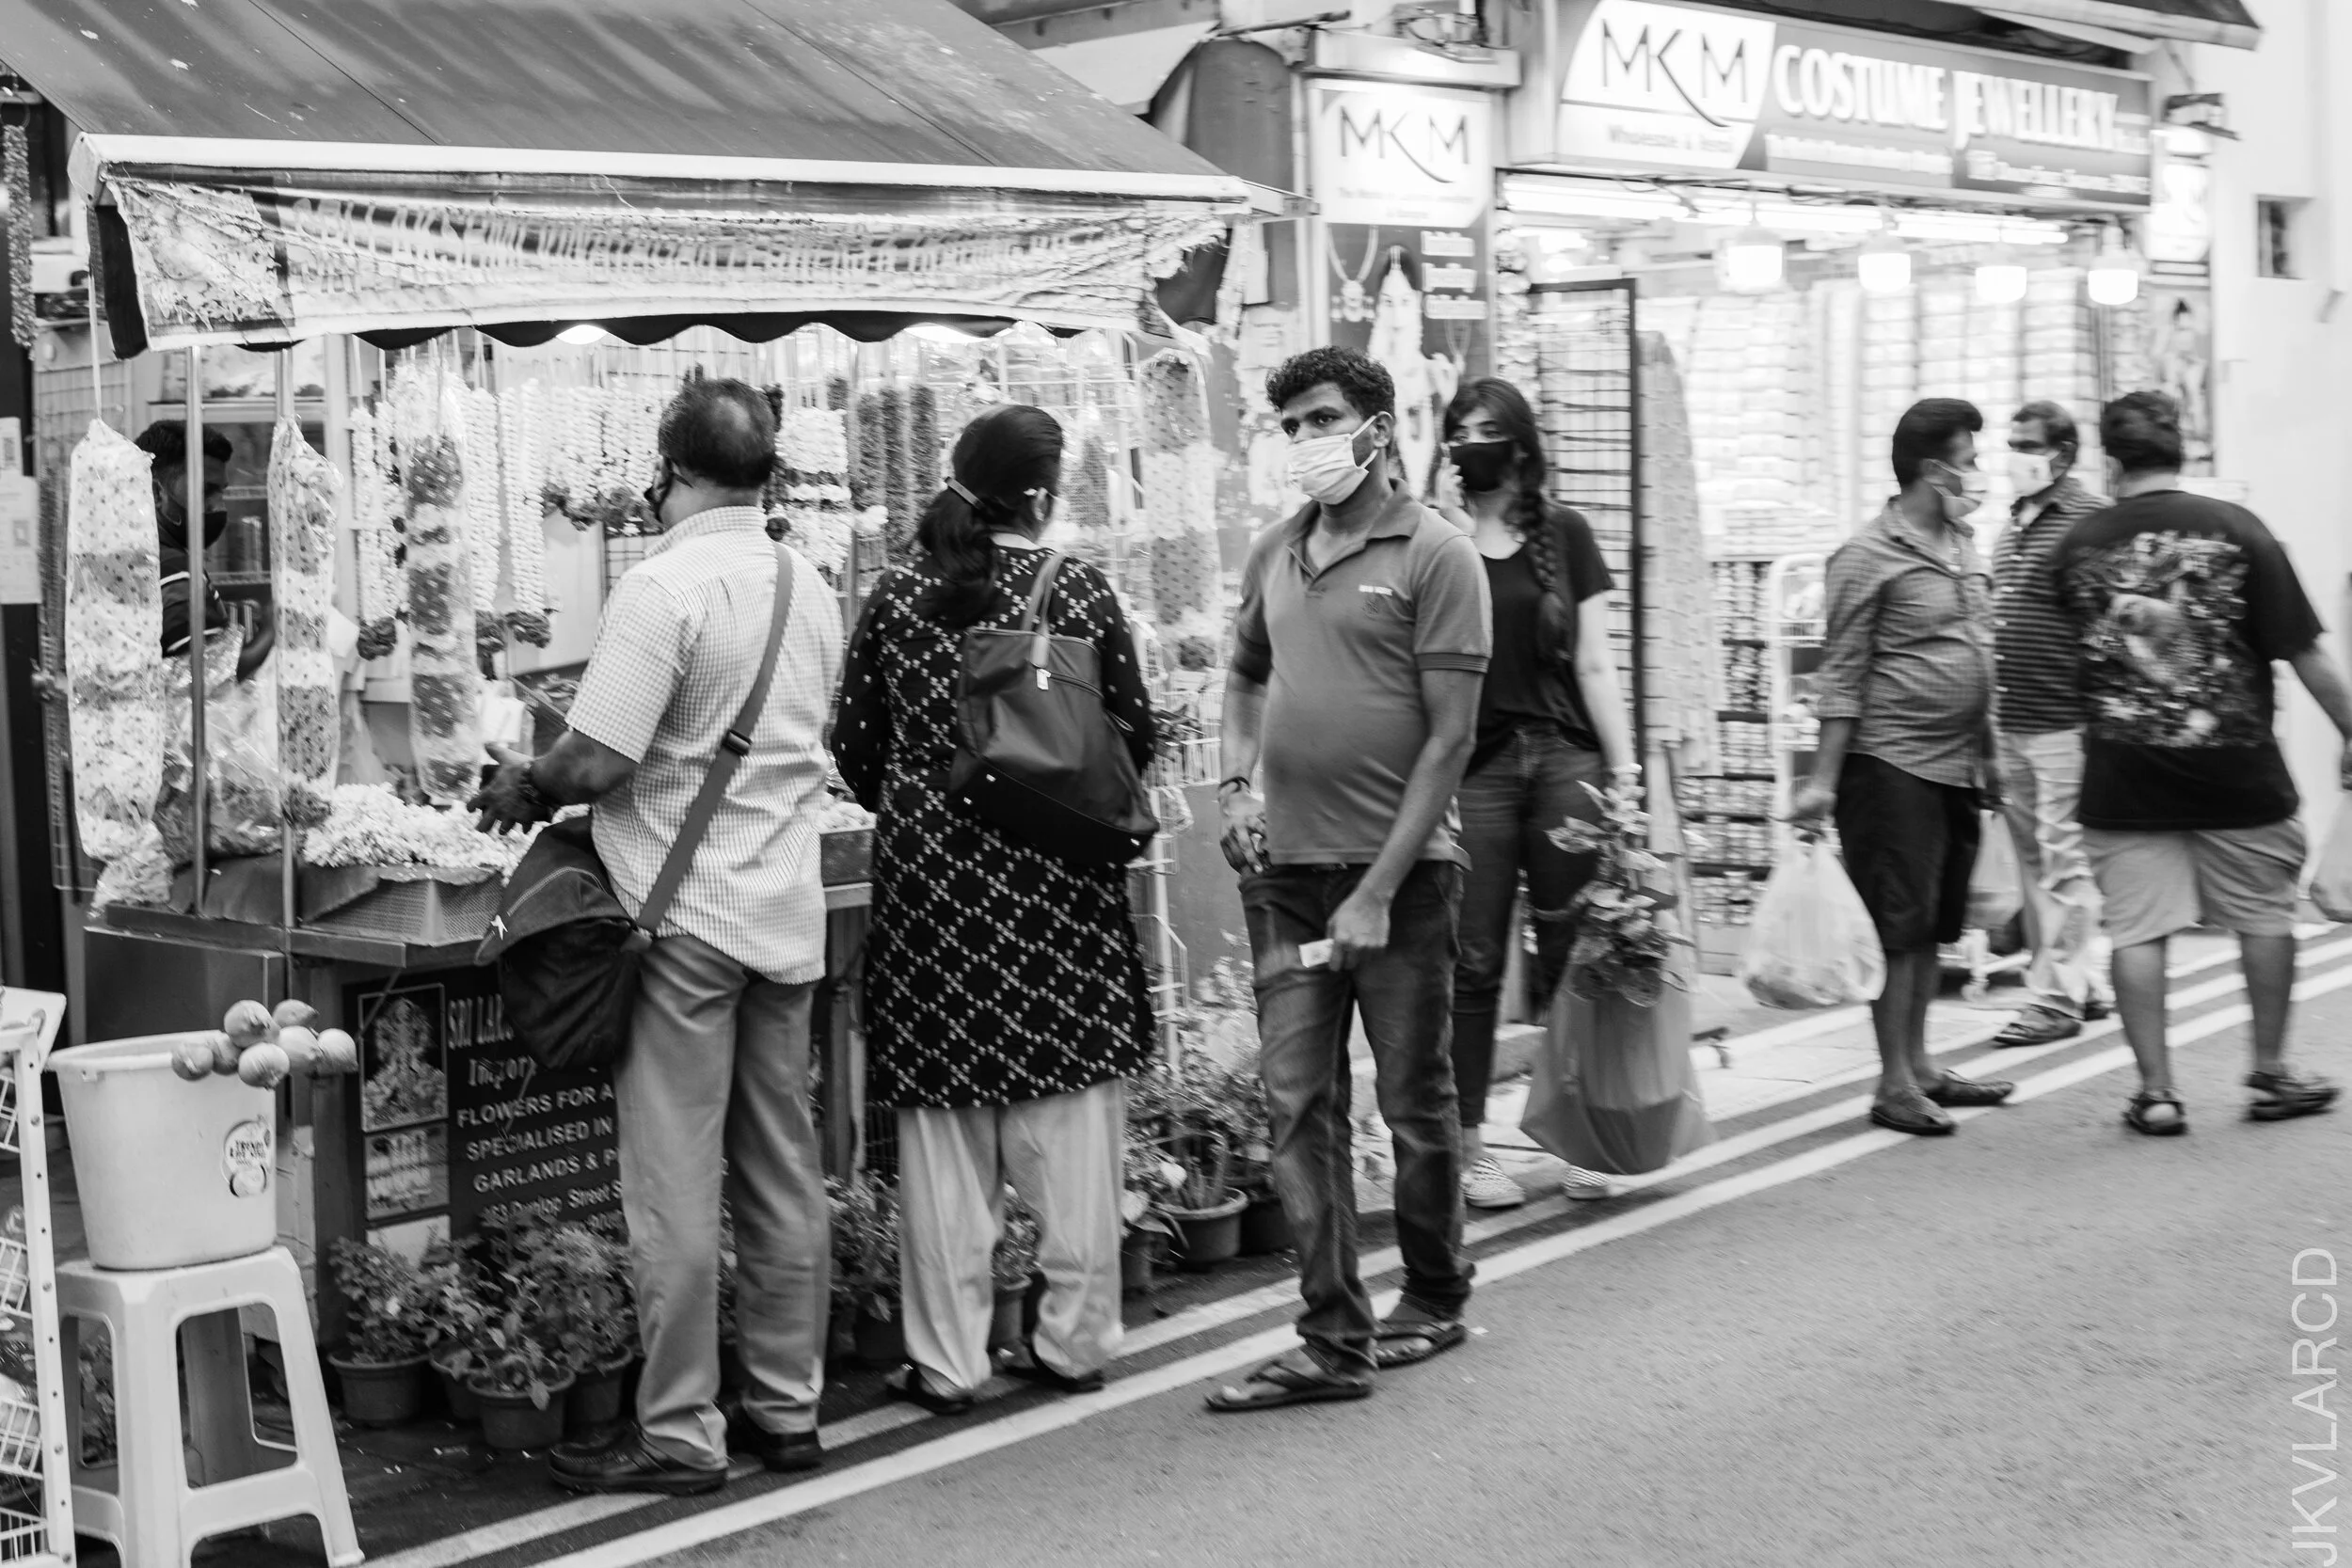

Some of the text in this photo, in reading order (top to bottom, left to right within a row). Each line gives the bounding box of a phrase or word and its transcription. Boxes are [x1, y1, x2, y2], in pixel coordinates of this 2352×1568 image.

[1601, 18, 1747, 128] MKM
[1772, 44, 1948, 131] COSTUME
[1951, 71, 2119, 150] JEWELLERY
[1340, 105, 1470, 183] MKM
[457, 1082, 615, 1129] FLOWERS FOR A
[466, 1115, 613, 1162] SPECIALISED IN
[473, 1153, 581, 1193] GARLANDS
[603, 1148, 618, 1166] P
